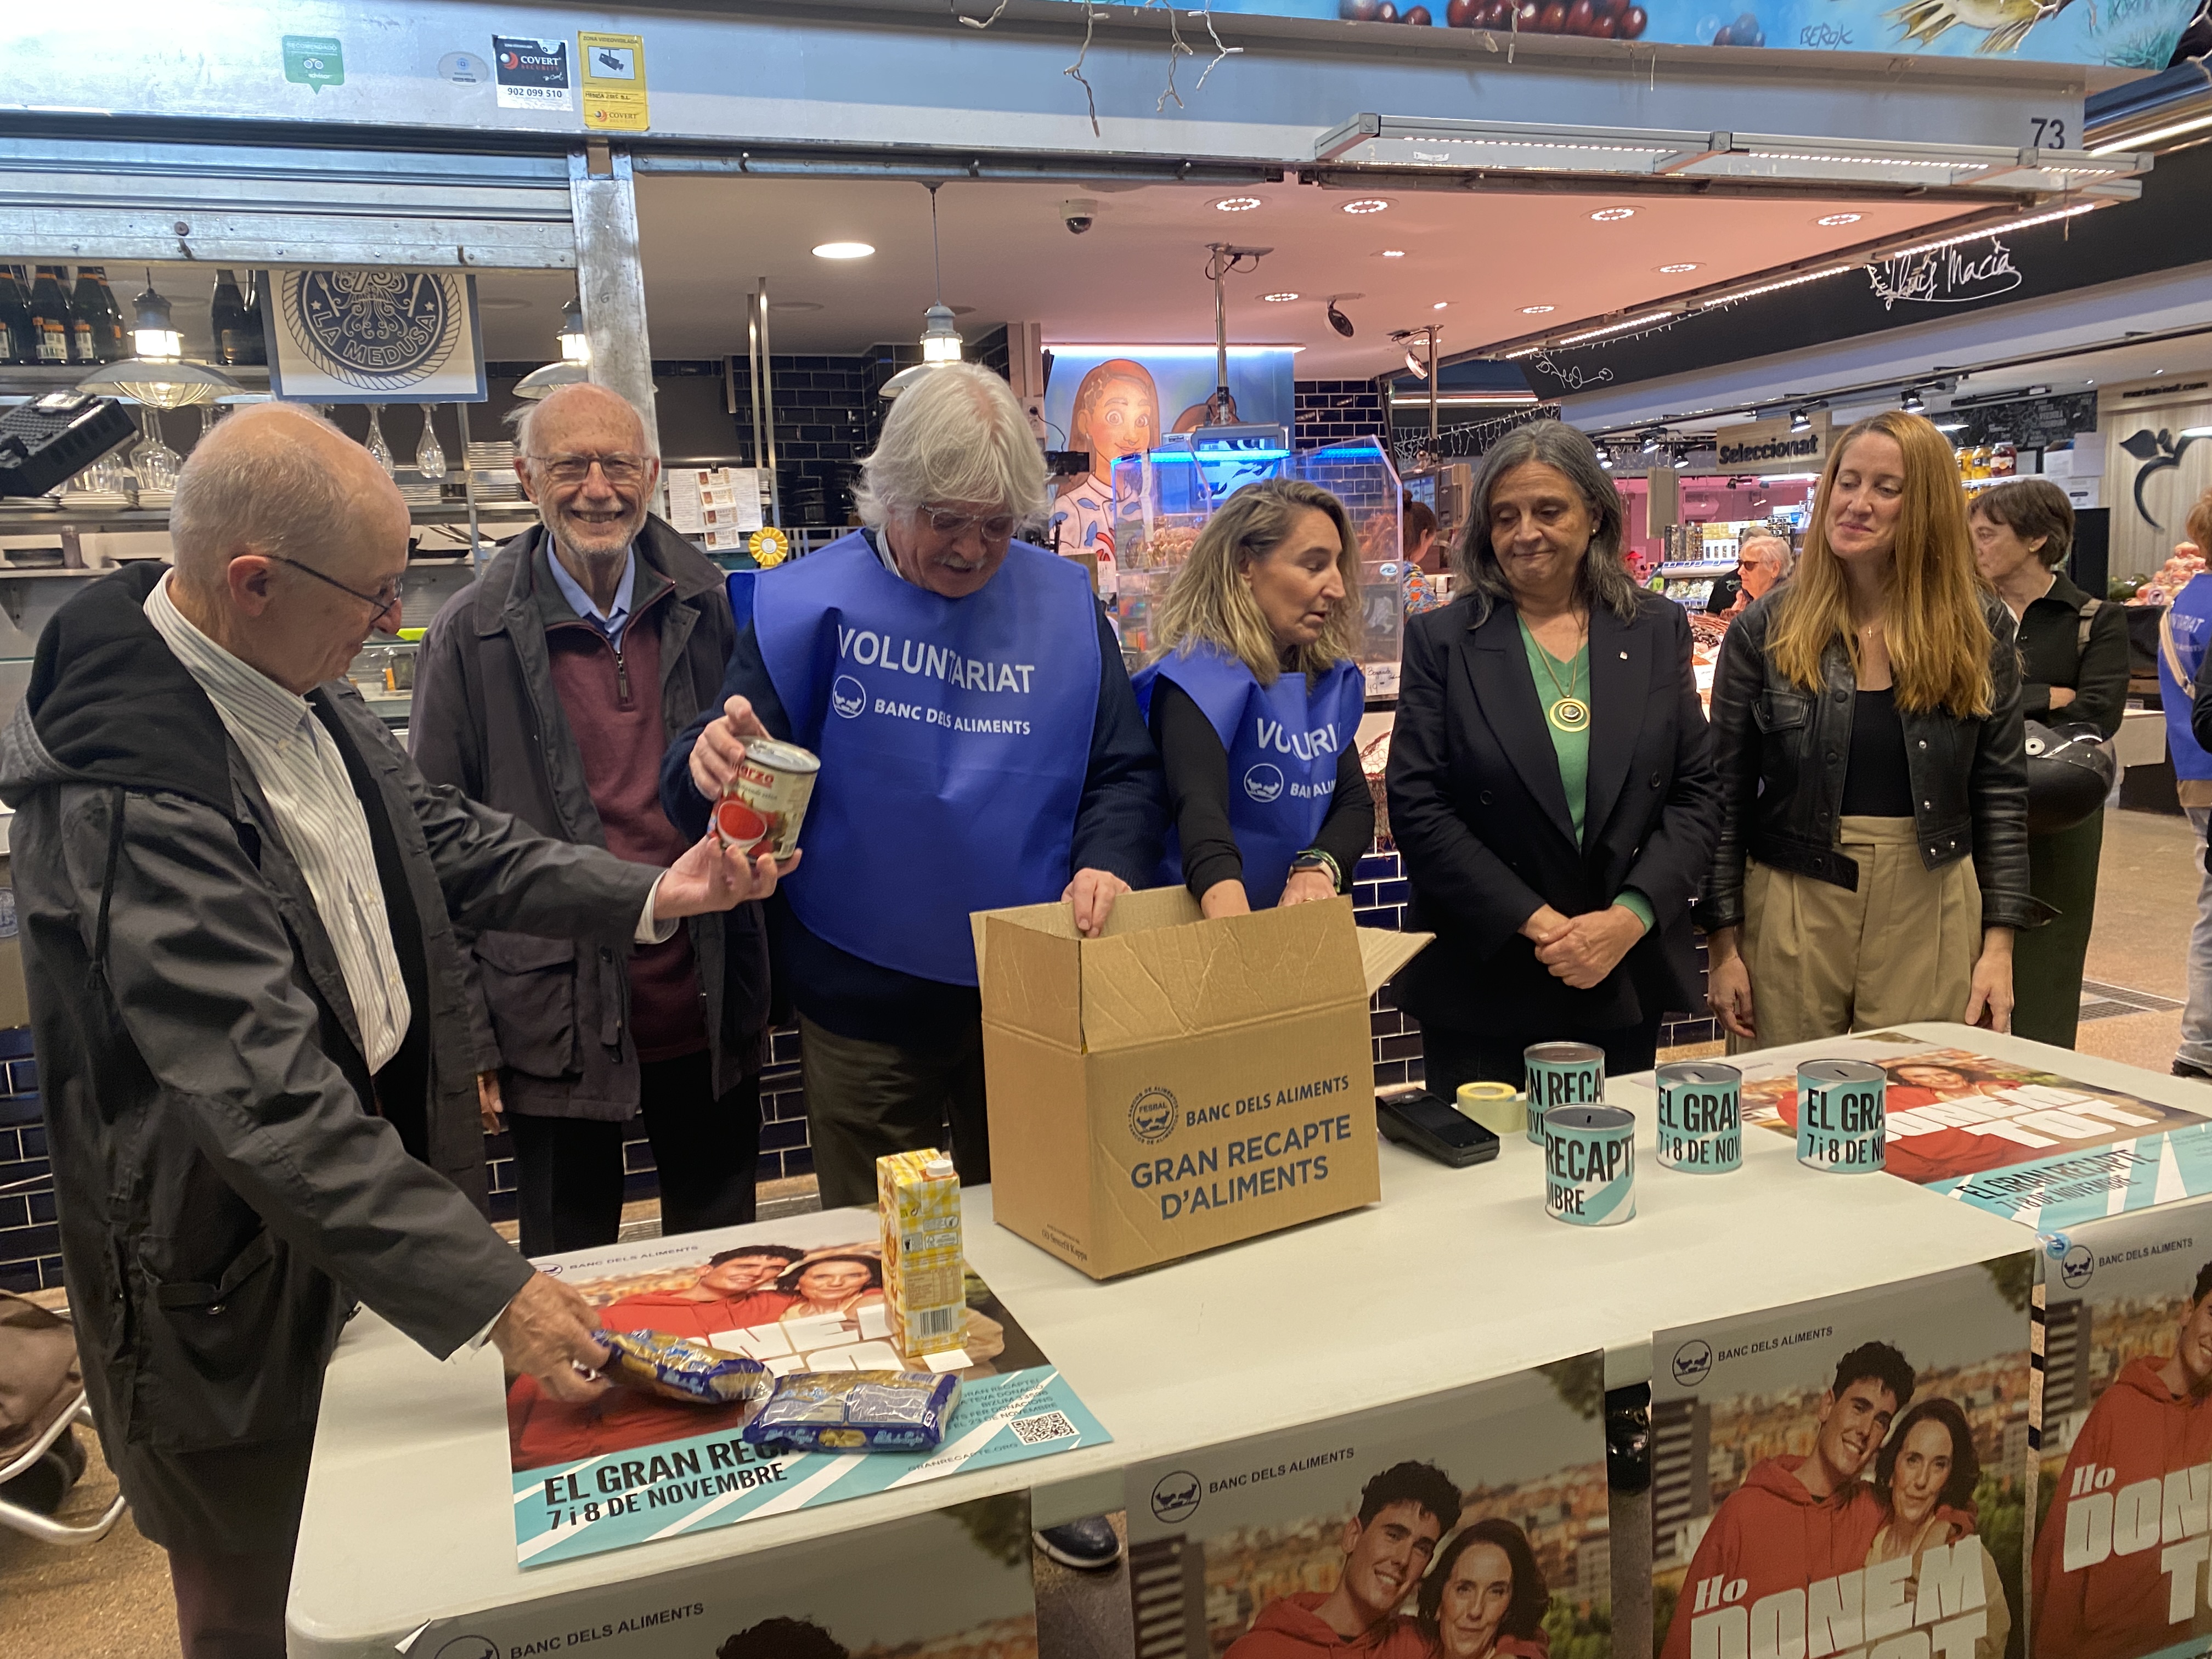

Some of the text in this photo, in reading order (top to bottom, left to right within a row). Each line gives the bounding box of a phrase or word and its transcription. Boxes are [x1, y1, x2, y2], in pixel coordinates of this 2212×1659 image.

[520, 55, 558, 65] COVERT
[507, 87, 562, 98] 902 099 510
[2030, 117, 2066, 149] 73
[312, 311, 436, 366] LA MEDUSA
[1718, 434, 1819, 465] Seleccionat
[837, 624, 1035, 694] VOLUNTARIAT
[874, 698, 1031, 736] BANC DELS ALIMENTS
[1186, 1075, 1350, 1127] BANC DELS ALIMENTS
[1658, 1085, 1740, 1133] EL GRAN
[1807, 1087, 1884, 1132] EL GRA
[1960, 1099, 2158, 1149] TOT
[1130, 1114, 1352, 1189] GRAN RECAPTE
[1658, 1130, 1663, 1155] 7
[1666, 1133, 1670, 1158] i
[1673, 1136, 1683, 1161] 8
[1688, 1138, 1710, 1165] DE
[1807, 1133, 1813, 1158] 7
[1819, 1136, 1823, 1161] i
[1828, 1138, 1840, 1164] 8
[1845, 1138, 1867, 1165] DE
[1161, 1155, 1329, 1221] D'ALIMENTS
[1954, 1149, 2160, 1200] EL GRAN RECAPTE
[2027, 1192, 2063, 1205] DE
[2049, 1174, 2142, 1201] NOVEMBRE
[569, 1245, 698, 1269] BANC DELS ALIMENTS
[2099, 1238, 2193, 1267] BANC DELS ALIMENTS
[1718, 1326, 1833, 1363] BANC DELS ALIMENTS
[991, 1396, 1054, 1413] DONACIONS
[1000, 1402, 1059, 1418] NOVEMBRE
[544, 1475, 590, 1506] EL
[596, 1447, 702, 1494] GRAN
[907, 1443, 1018, 1471] GRANRECAPTE.ORG
[1209, 1446, 1355, 1494] BANC DELS ALIMENTS
[546, 1462, 788, 1531] 7 i 8 DE NOVEMBRE
[2063, 1462, 2212, 1573] DON
[1690, 1534, 1988, 1659] DONEM
[1693, 1573, 1748, 1614] Ho
[2160, 1536, 2212, 1626] T
[510, 1602, 704, 1659] BANC DELS ALIMENTS
